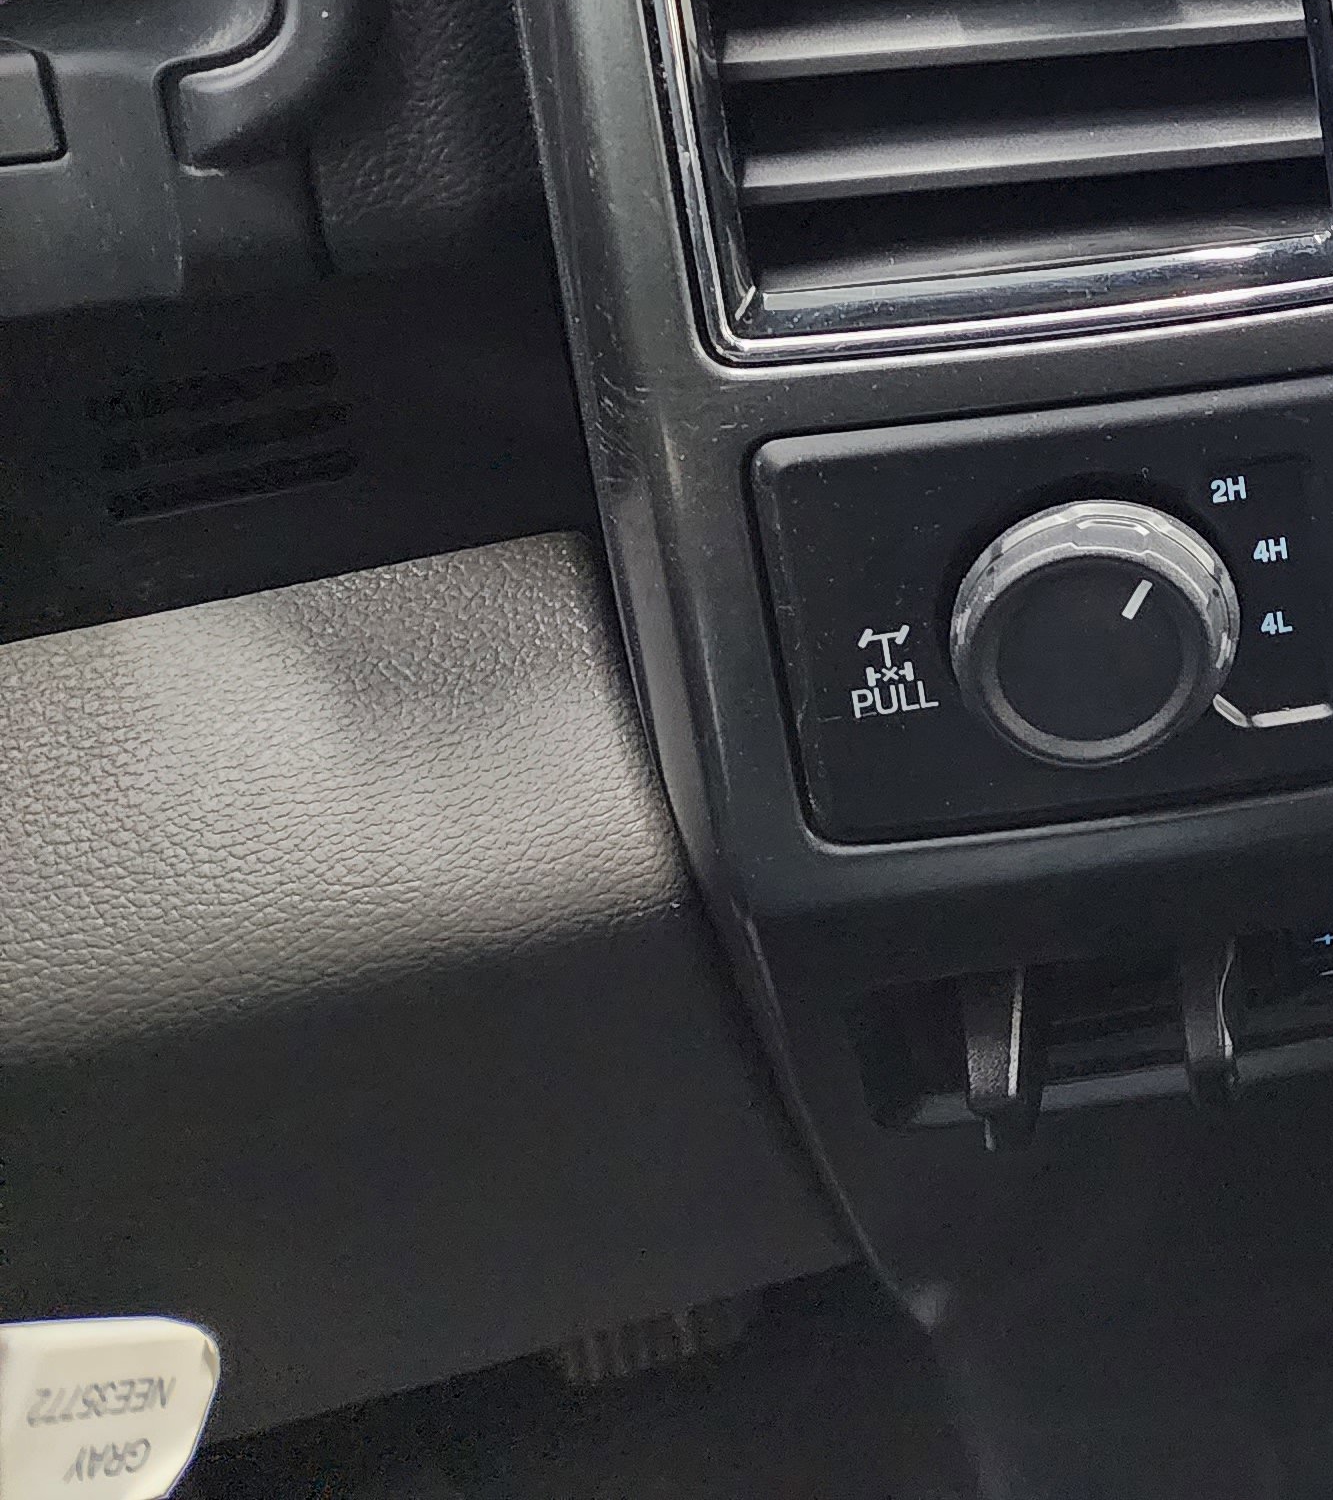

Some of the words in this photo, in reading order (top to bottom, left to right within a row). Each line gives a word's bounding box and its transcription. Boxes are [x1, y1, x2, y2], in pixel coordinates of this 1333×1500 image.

[1211, 476, 1247, 503] 2H
[1253, 537, 1288, 563] 4H
[1260, 611, 1293, 635] 4L
[851, 680, 939, 718] PULL
[62, 1437, 151, 1484] GRAY
